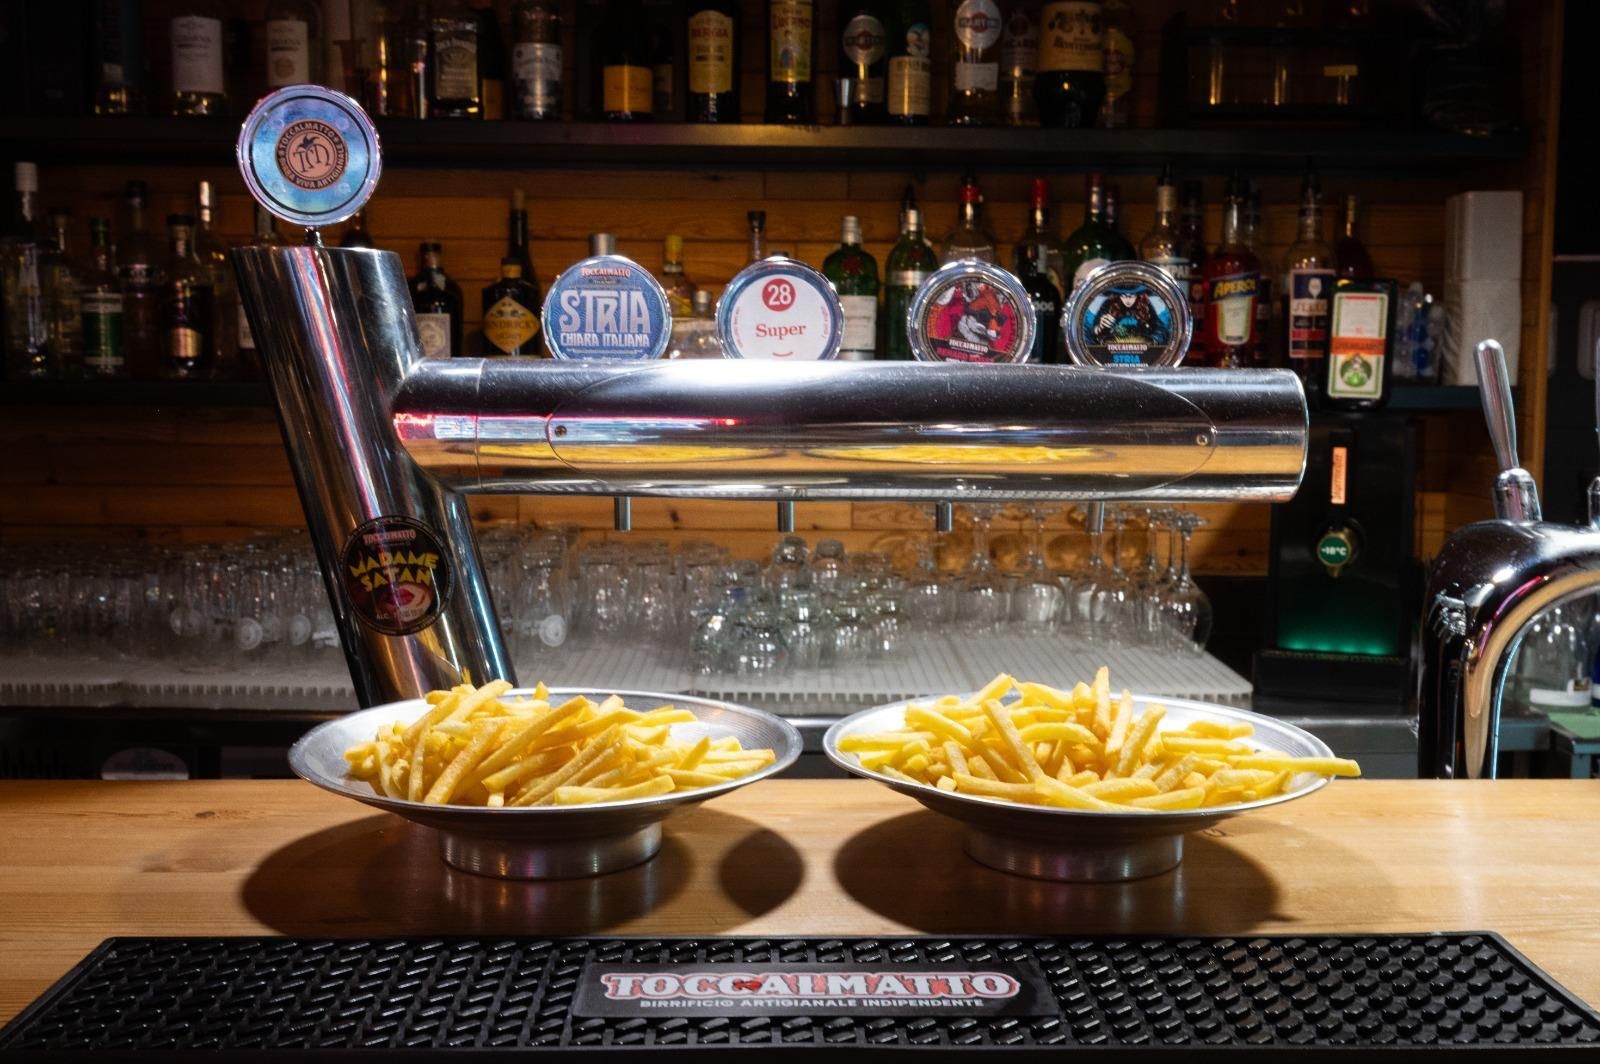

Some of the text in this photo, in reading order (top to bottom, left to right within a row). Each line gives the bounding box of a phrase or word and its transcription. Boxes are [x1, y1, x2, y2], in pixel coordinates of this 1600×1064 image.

[280, 122, 336, 149] TOCCALMATTO
[767, 283, 793, 306] 28
[559, 288, 652, 333] STRIA
[560, 332, 651, 348] CHIARA ITALIANA
[754, 322, 807, 341] Super
[348, 550, 440, 578] MADAME
[360, 566, 433, 593] SATAN
[602, 972, 1020, 999] TOCCALMATTO
[640, 999, 985, 1008] BIRRIFICIO ARTIGIANALE INDIPENDENTE
